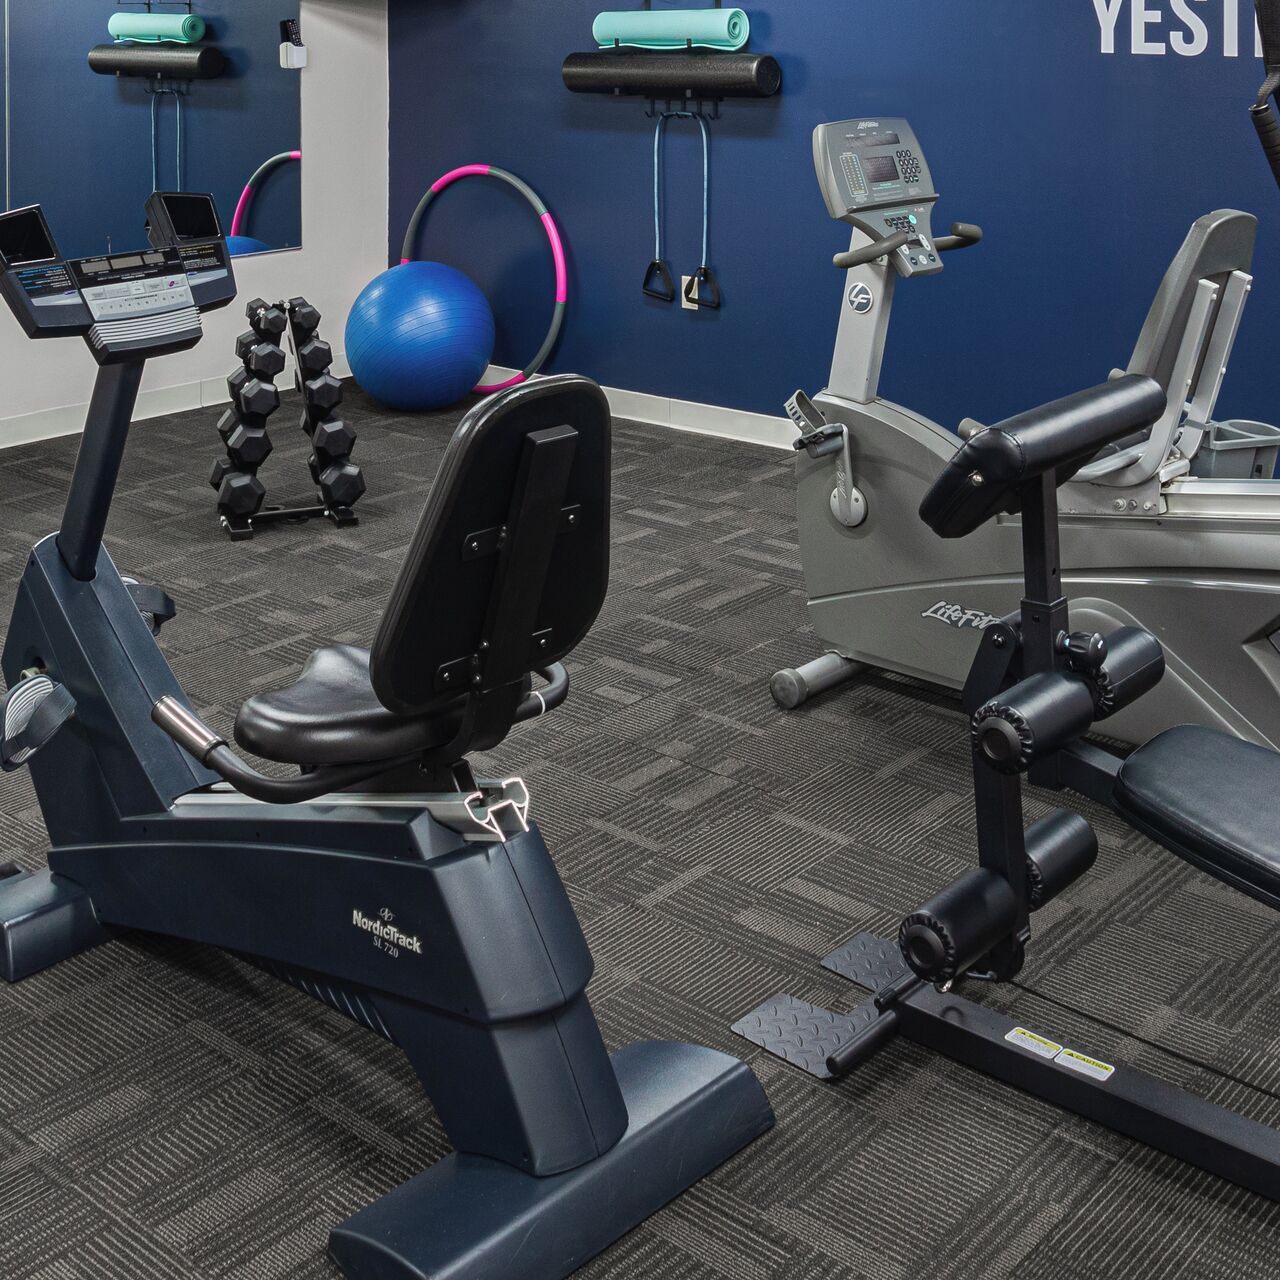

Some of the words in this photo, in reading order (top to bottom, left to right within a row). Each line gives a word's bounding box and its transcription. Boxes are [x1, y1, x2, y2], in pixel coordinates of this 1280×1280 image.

[352, 909, 423, 955] NordicTrack
[373, 935, 383, 949] SL
[384, 942, 399, 959] 720
[1075, 1054, 1109, 1071] CAUTION
